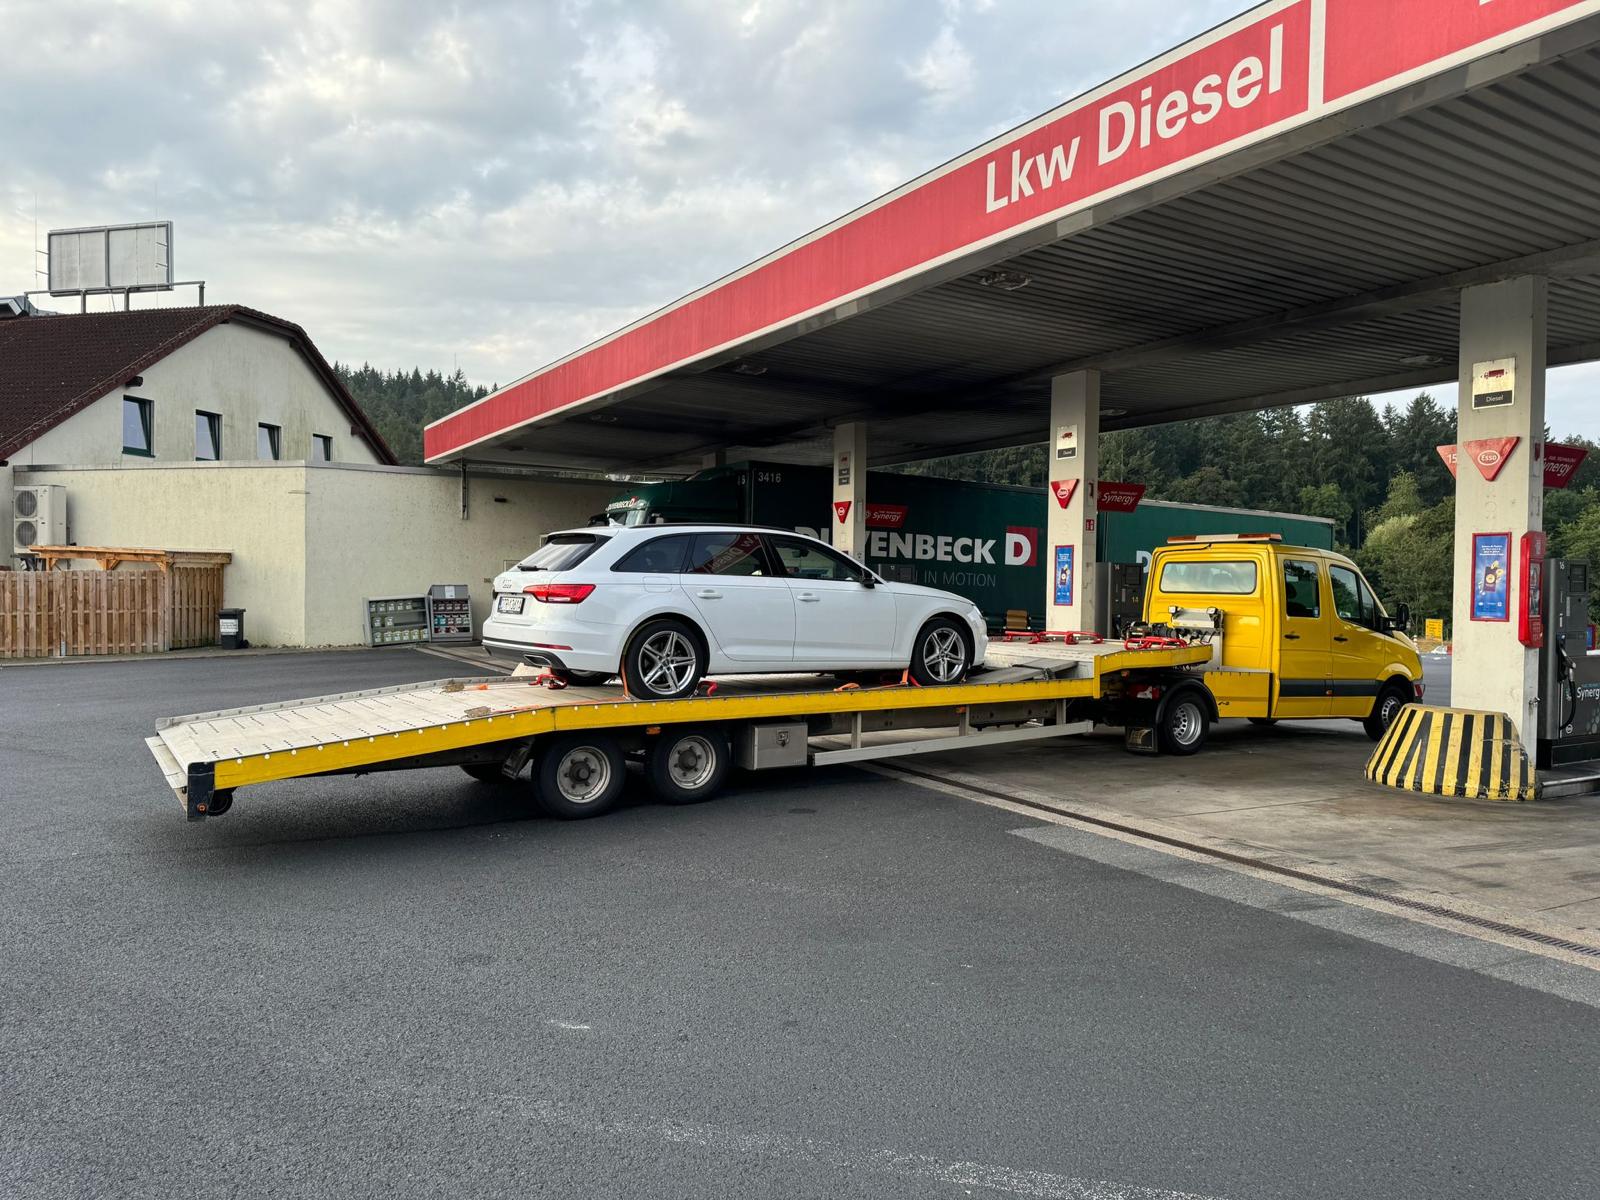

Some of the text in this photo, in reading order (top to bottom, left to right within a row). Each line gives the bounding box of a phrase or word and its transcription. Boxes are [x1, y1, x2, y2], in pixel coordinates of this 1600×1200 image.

[984, 24, 1284, 213] Lkw Diesel
[1486, 395, 1504, 403] Diesel
[1448, 453, 1457, 464] 15
[1479, 454, 1498, 462] Esso
[1544, 459, 1572, 477] ynergy
[758, 472, 782, 484] 3416
[1101, 492, 1136, 505] Synergy
[872, 512, 901, 522] Synergy
[795, 526, 998, 565] ENBECK
[924, 568, 937, 584] IN
[943, 571, 996, 588] MOTION
